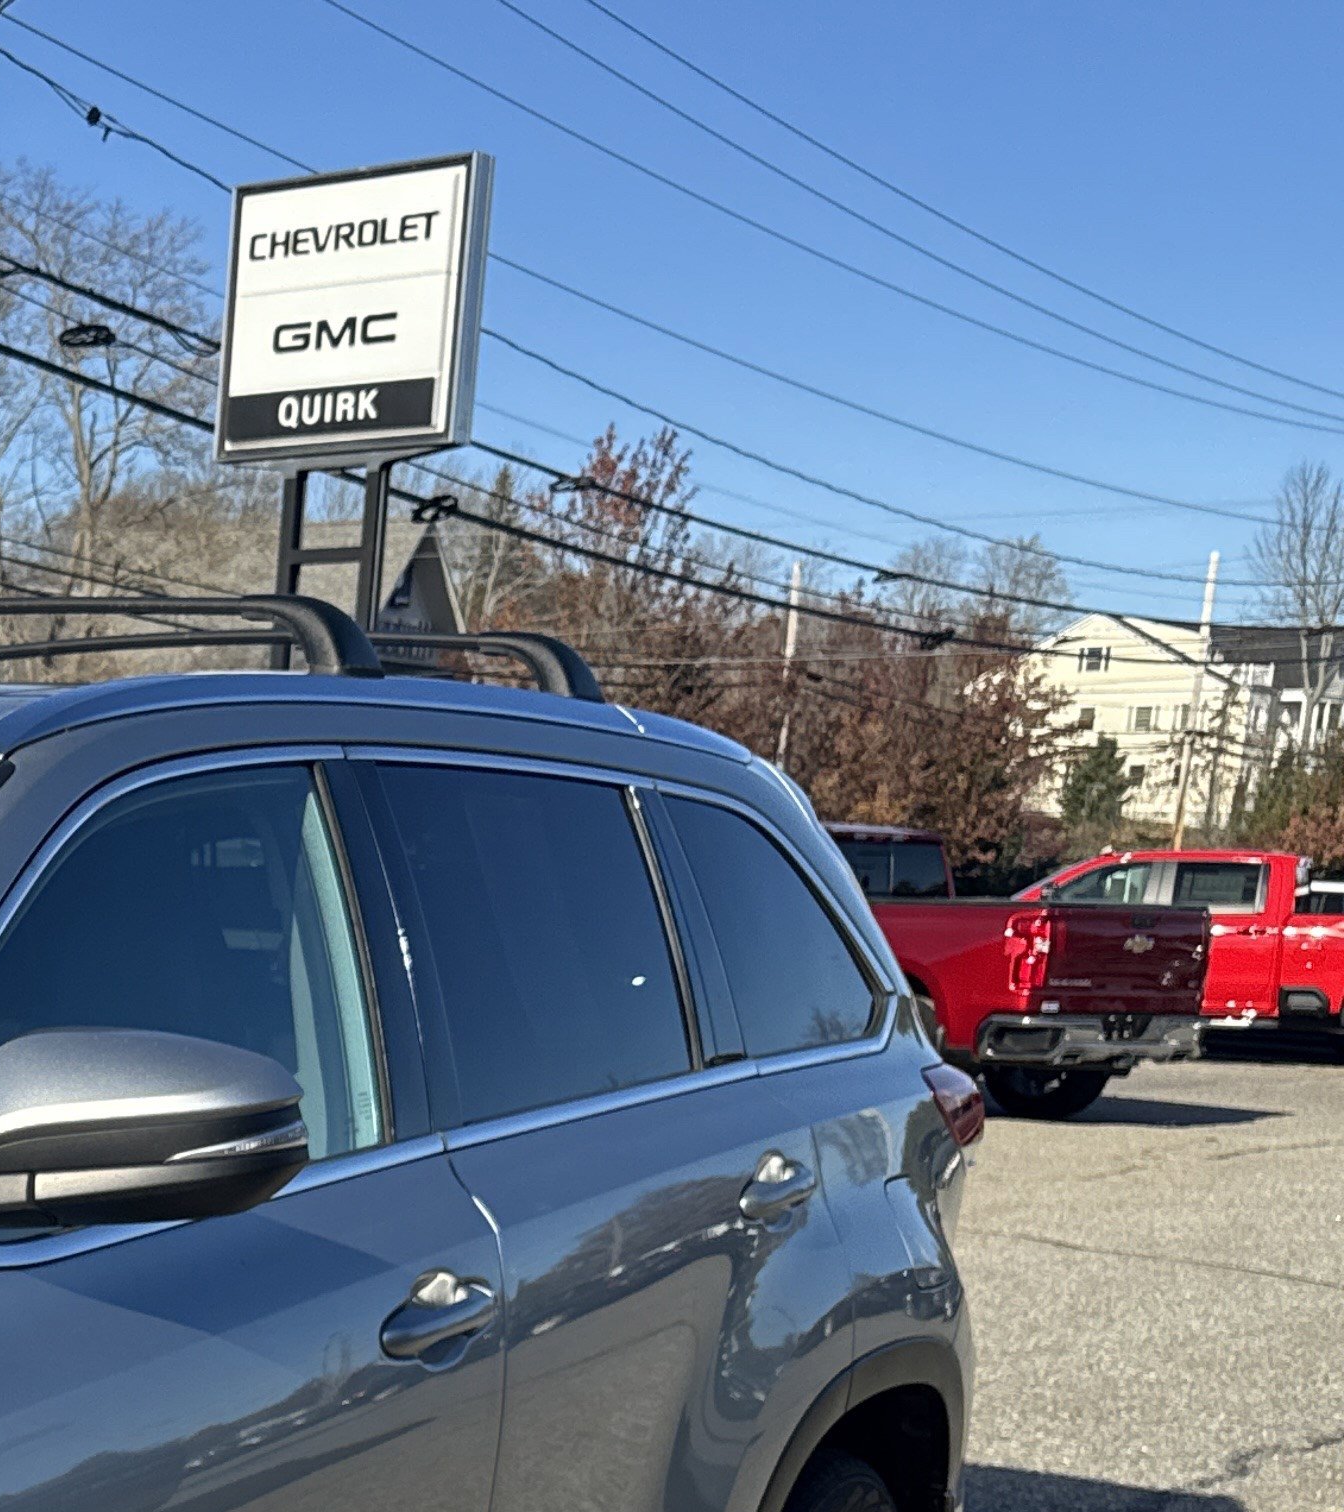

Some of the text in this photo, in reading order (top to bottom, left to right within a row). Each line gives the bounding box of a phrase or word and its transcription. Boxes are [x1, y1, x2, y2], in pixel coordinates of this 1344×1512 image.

[248, 210, 440, 262] CHEVROLET
[272, 311, 398, 354] GMC
[277, 387, 380, 429] QUIRK
